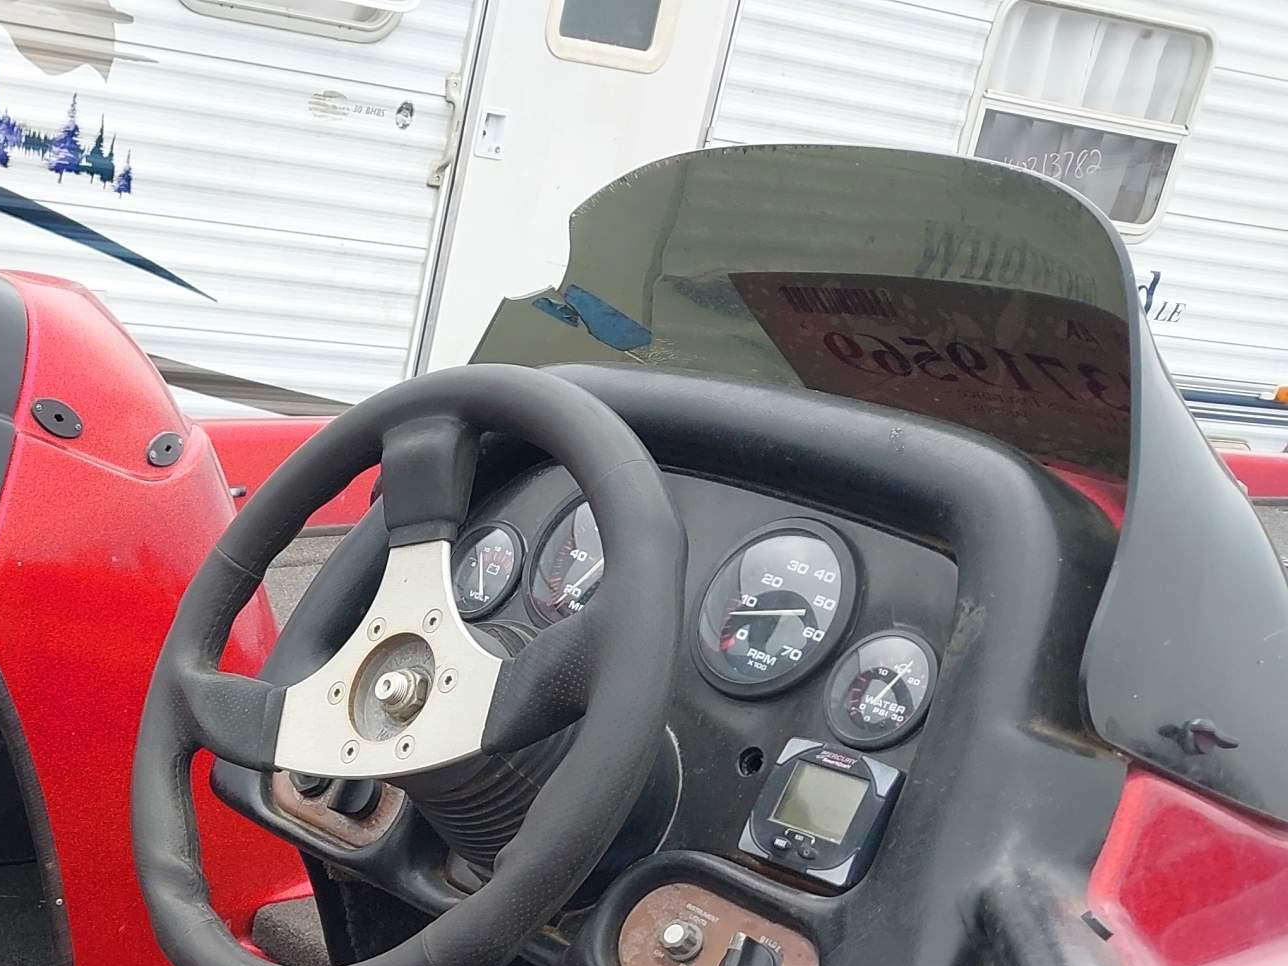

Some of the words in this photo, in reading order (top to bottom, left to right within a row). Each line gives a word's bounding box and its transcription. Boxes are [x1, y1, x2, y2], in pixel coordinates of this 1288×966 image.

[569, 549, 588, 562] 40
[787, 560, 810, 575] 30
[761, 573, 784, 588] 20
[814, 569, 836, 583] 40
[469, 589, 490, 603] VOLT
[741, 594, 758, 608] 10
[813, 595, 836, 610] 50
[735, 628, 748, 640] 0
[802, 626, 825, 642] 60
[747, 648, 777, 666] RPM
[781, 645, 803, 661] 70
[878, 668, 889, 676] 10
[865, 694, 906, 714] WATER
